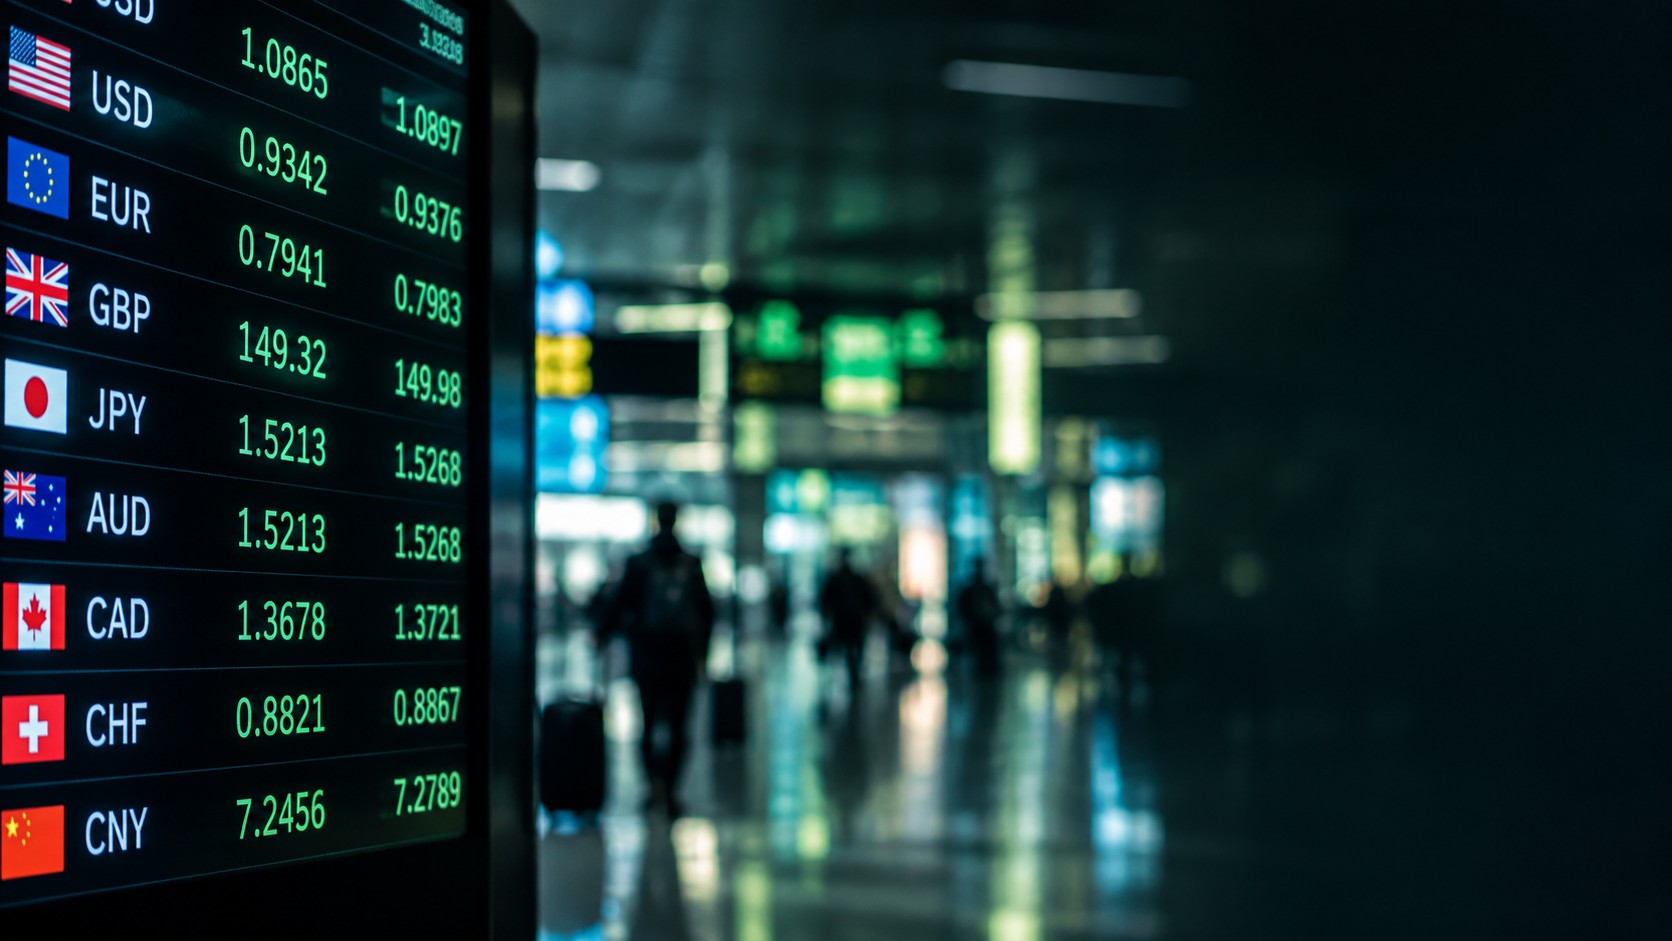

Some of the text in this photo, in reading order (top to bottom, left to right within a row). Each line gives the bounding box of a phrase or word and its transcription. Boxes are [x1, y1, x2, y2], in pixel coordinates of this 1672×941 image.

[241, 26, 463, 156] 1.0865 1.0897
[92, 69, 462, 243] USD 0.9342 0.9376
[91, 175, 462, 328] EUR 0.7941 0.7983
[89, 282, 462, 409] GBP 149.32 149.98
[88, 387, 462, 487] JPY 1.5213 1.5268
[86, 491, 461, 563] AUD 1.5213 1.5268
[86, 596, 461, 641] CAD 1.3678 1.3721
[85, 686, 461, 747] CHF 0.8821 0.8867
[85, 770, 461, 856] CNY 7.2456 7.2789
